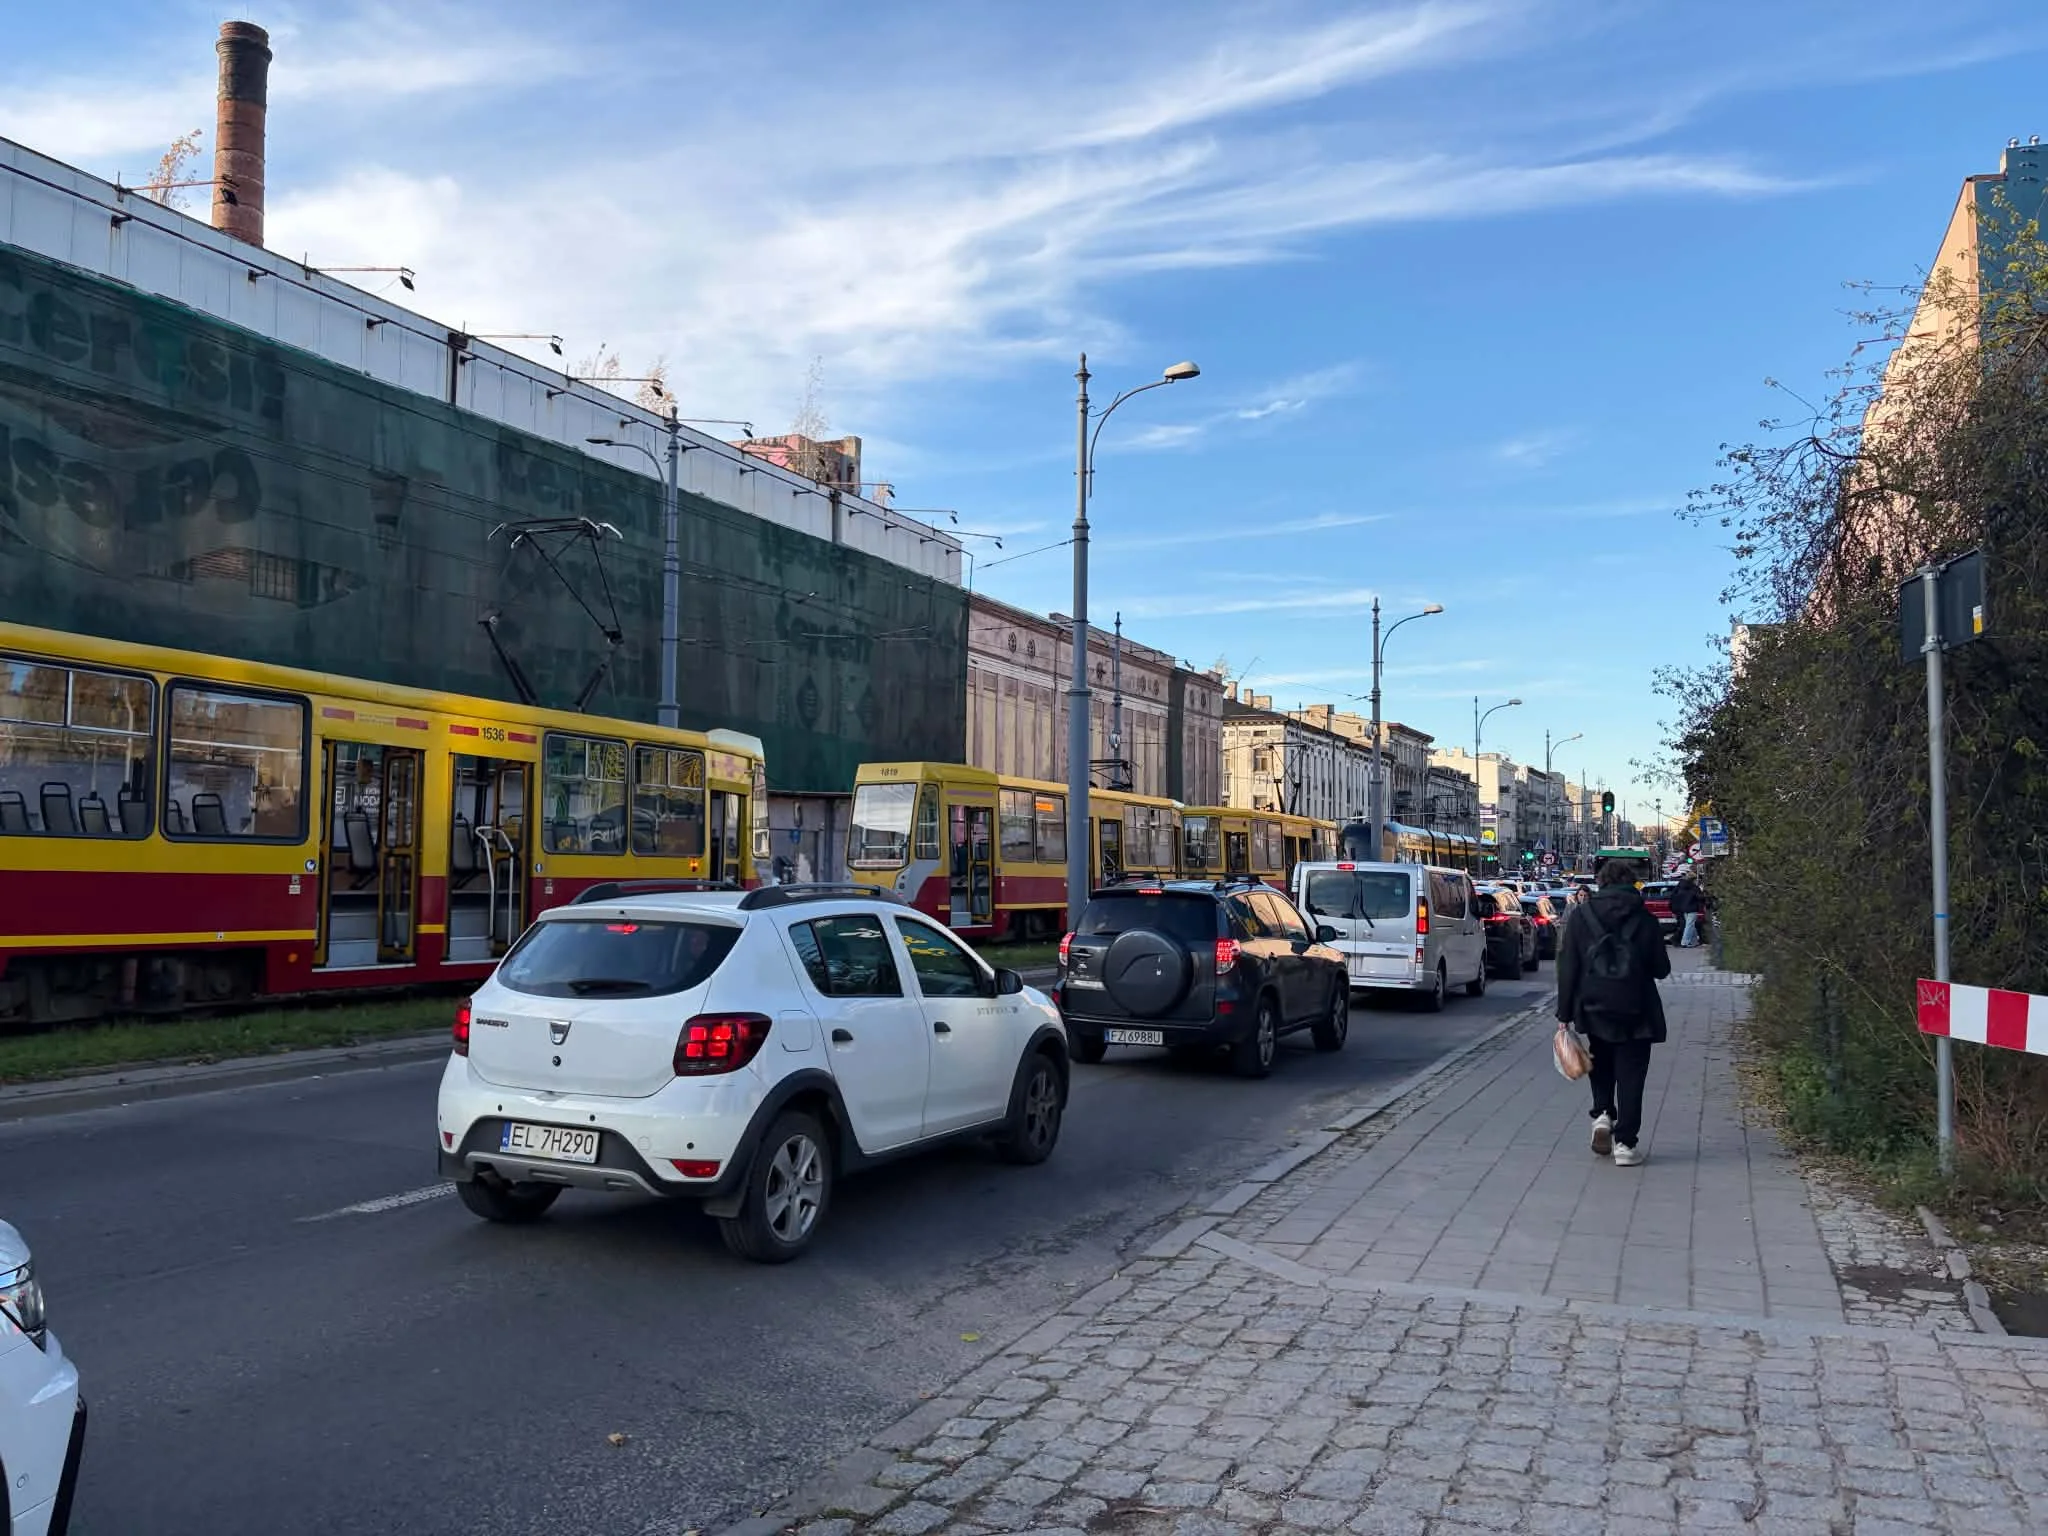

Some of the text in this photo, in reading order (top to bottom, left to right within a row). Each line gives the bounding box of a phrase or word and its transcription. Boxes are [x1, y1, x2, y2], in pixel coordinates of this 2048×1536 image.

[481, 726, 505, 742] 1536
[511, 1125, 594, 1156] EL 7H290
